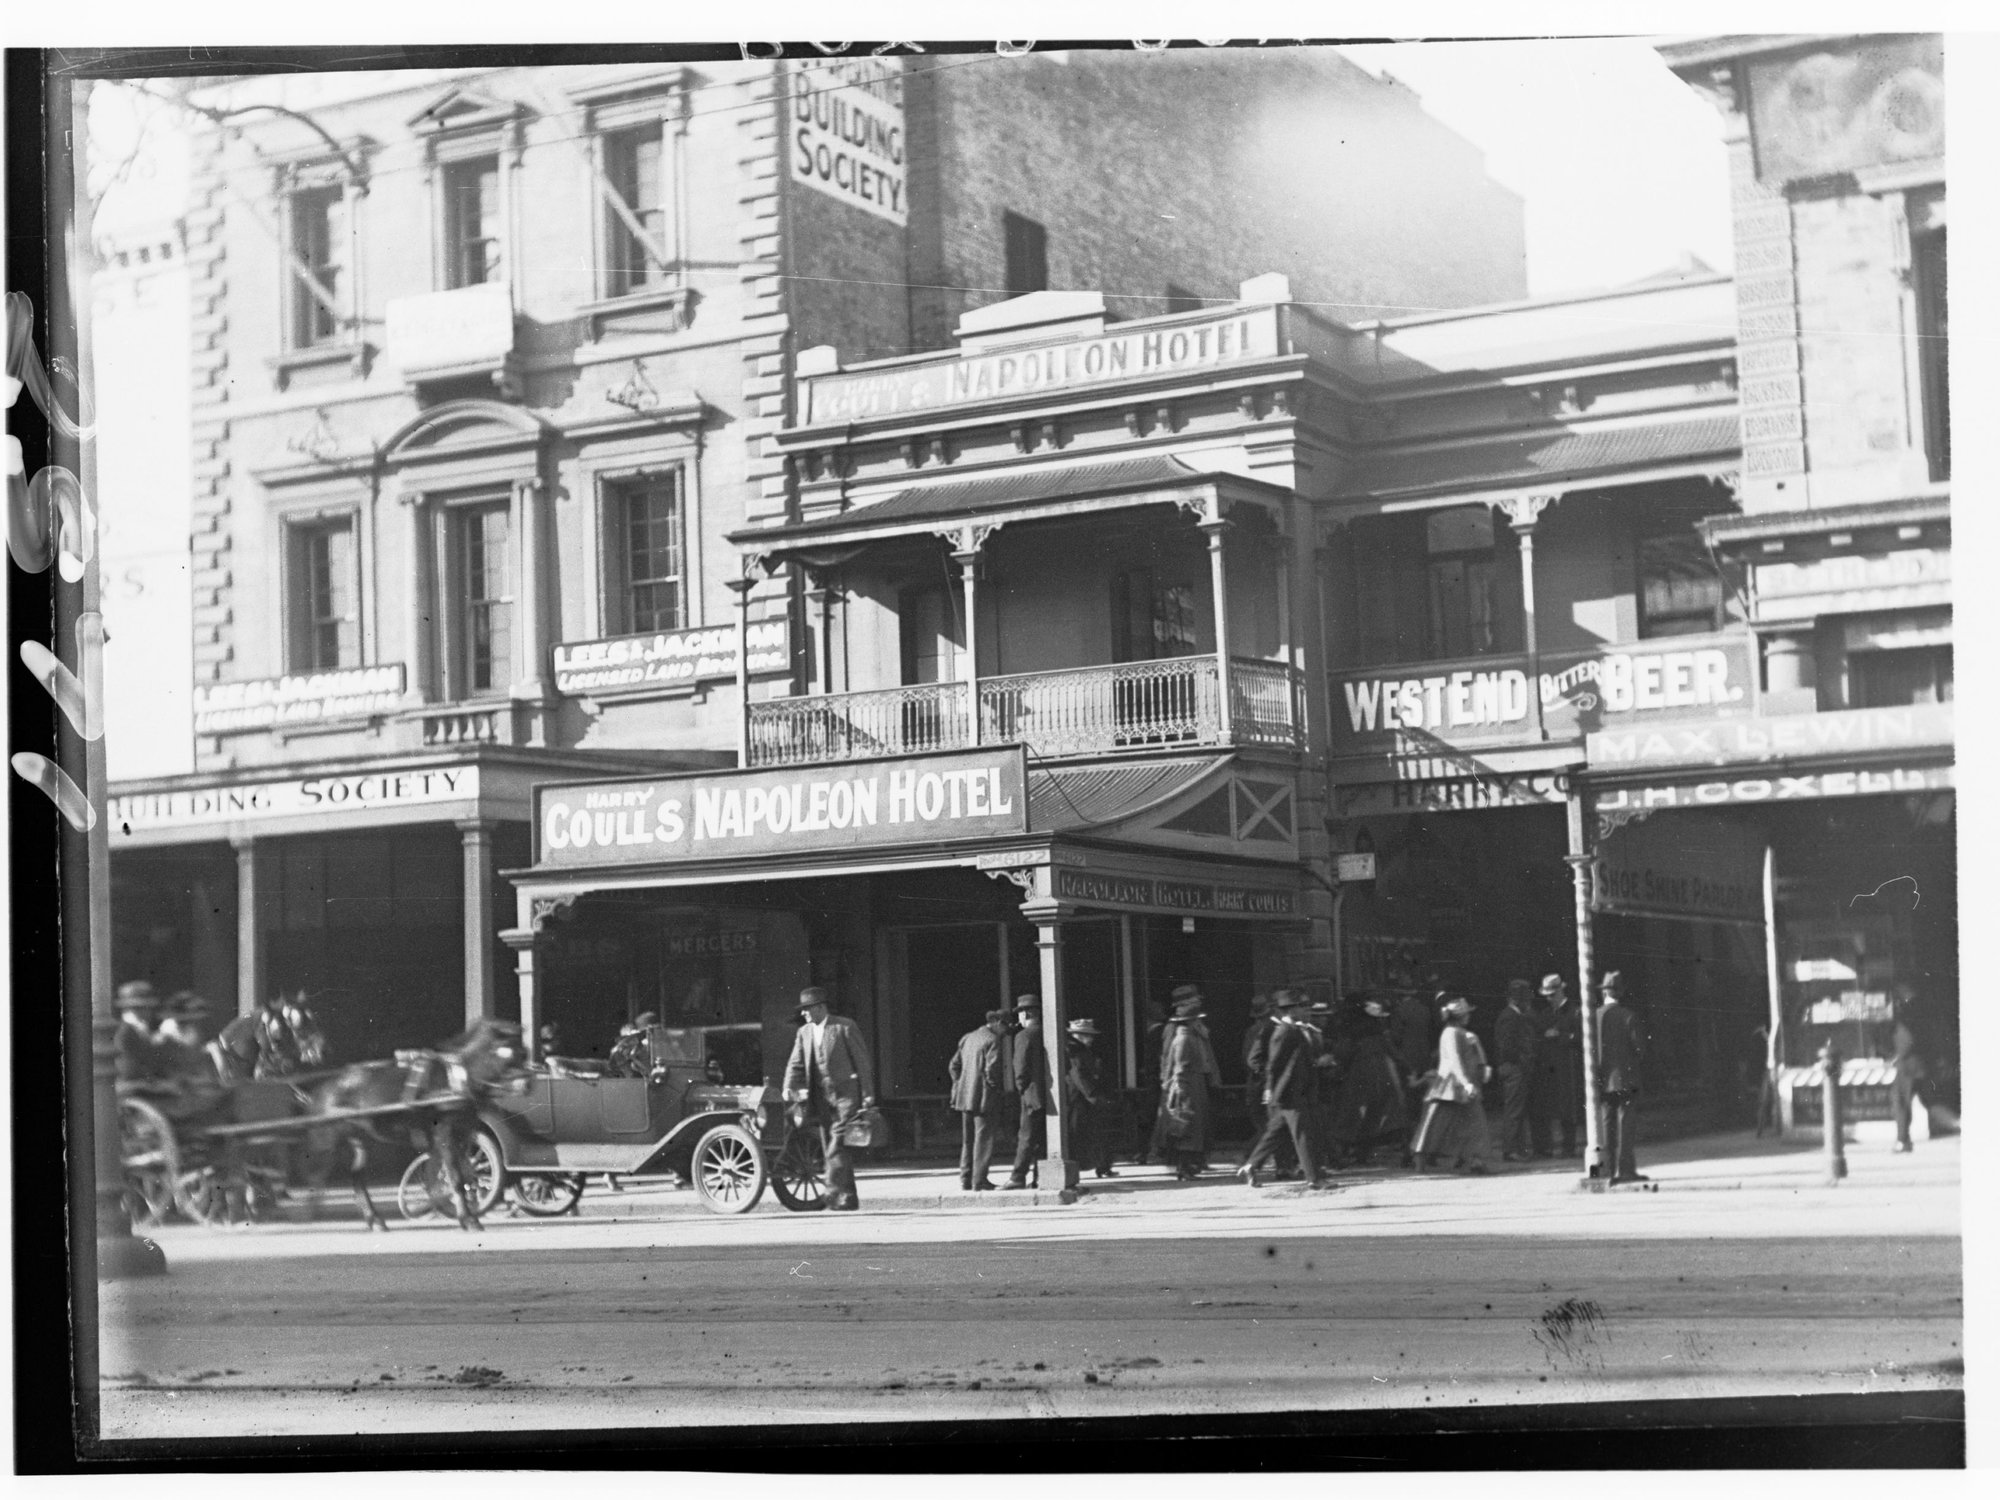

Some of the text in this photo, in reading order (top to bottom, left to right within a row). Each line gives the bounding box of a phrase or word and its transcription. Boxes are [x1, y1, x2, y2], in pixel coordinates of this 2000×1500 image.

[797, 72, 902, 165] BUILDING
[947, 339, 1129, 401] NAPOLEON
[1141, 320, 1253, 375] HOTEL
[554, 641, 629, 673] LEES
[557, 667, 645, 693] LICENSED
[645, 661, 694, 682] LAND
[1344, 676, 1447, 732] WEST
[1449, 669, 1528, 729] END
[1539, 659, 1603, 703] BITTER
[1598, 728, 1713, 762] MAX
[298, 772, 464, 806] SOCIETY
[586, 786, 656, 809] HARRY
[693, 777, 878, 841] NAPOLEON
[888, 767, 1013, 824] HOTEL
[1393, 776, 1515, 807] HARRY
[1599, 862, 1640, 900] SHOE
[1645, 868, 1688, 904] SHINE
